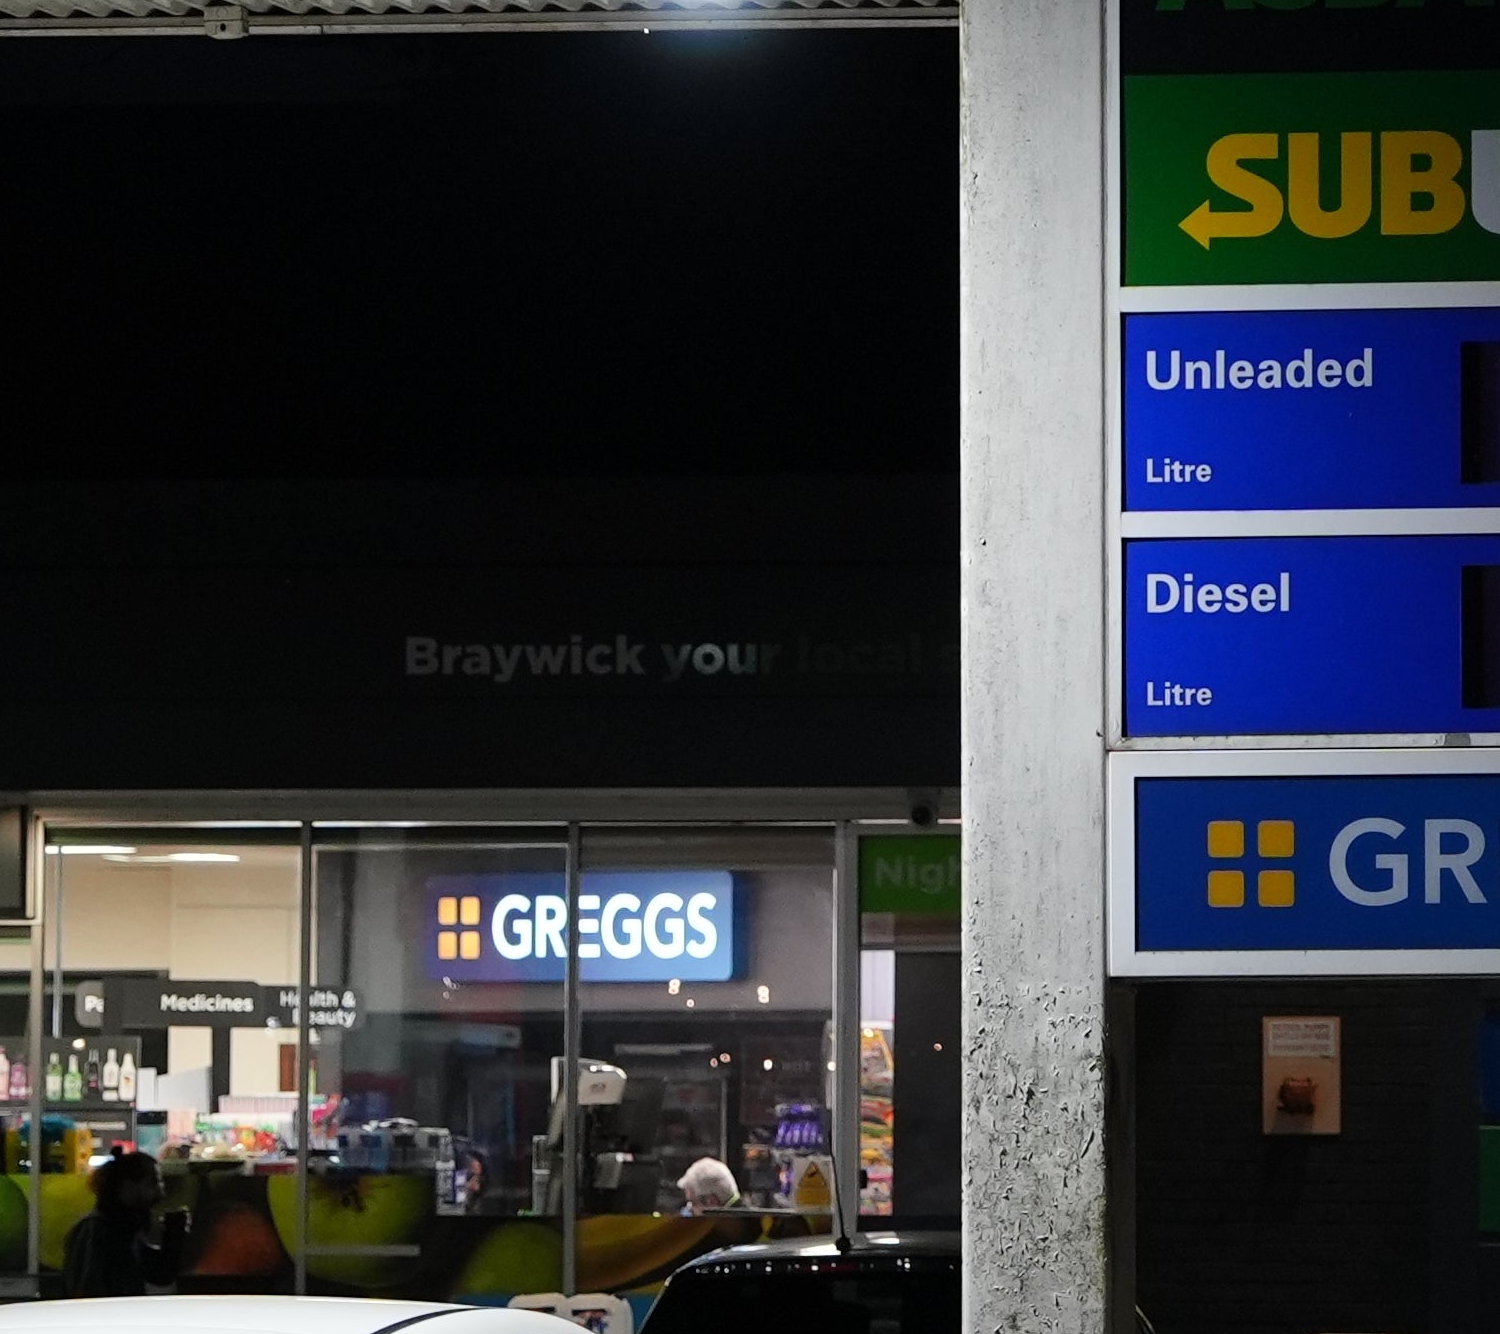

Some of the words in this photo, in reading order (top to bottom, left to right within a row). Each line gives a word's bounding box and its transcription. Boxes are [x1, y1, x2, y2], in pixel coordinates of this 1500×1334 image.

[1144, 347, 1374, 392] Unleaded
[1145, 457, 1213, 485] Litre
[1144, 572, 1291, 615] Diesel
[403, 633, 647, 683] Braywick
[659, 641, 781, 683] your
[1145, 680, 1213, 708] Litre
[490, 890, 719, 961] GREGGS
[160, 993, 255, 1013] Medicines
